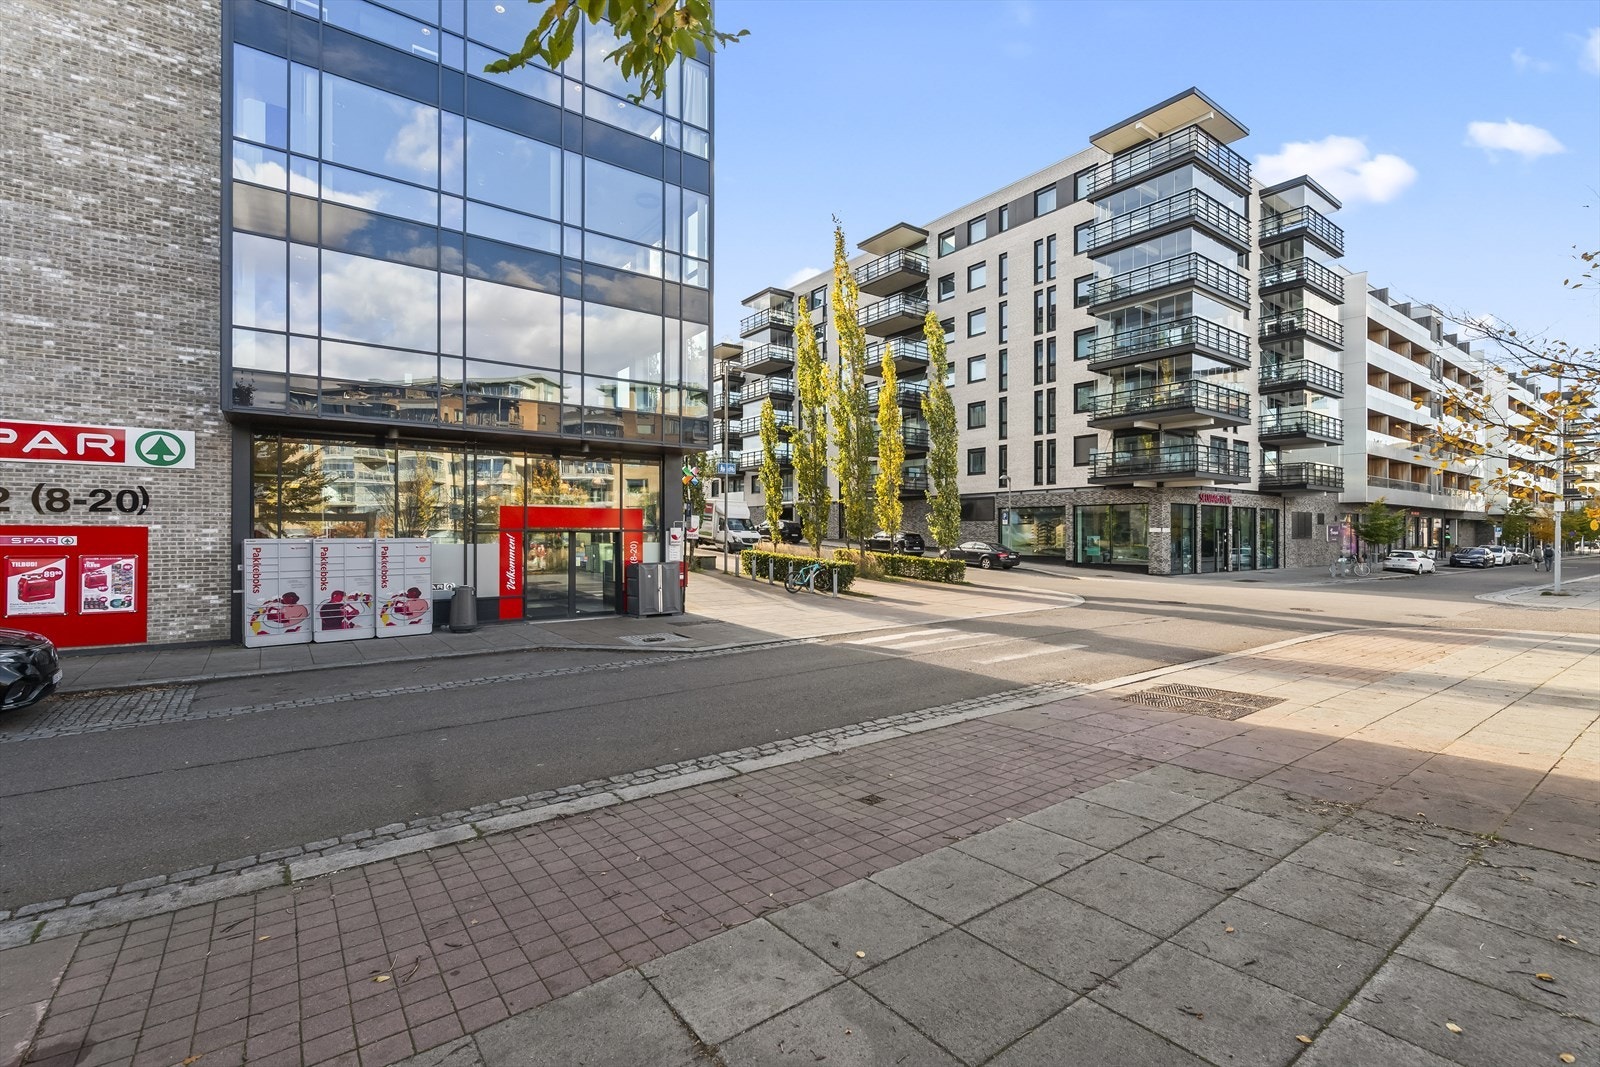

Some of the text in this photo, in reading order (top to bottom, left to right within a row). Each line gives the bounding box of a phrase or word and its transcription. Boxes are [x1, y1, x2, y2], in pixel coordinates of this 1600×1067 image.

[31, 482, 150, 516] (8-20)
[252, 547, 262, 594] Pakkeboks
[320, 546, 329, 592] Pakkeboks
[380, 546, 389, 589] Pakkeboks
[505, 532, 516, 590] Velkommen!
[629, 540, 639, 564] (8-20)
